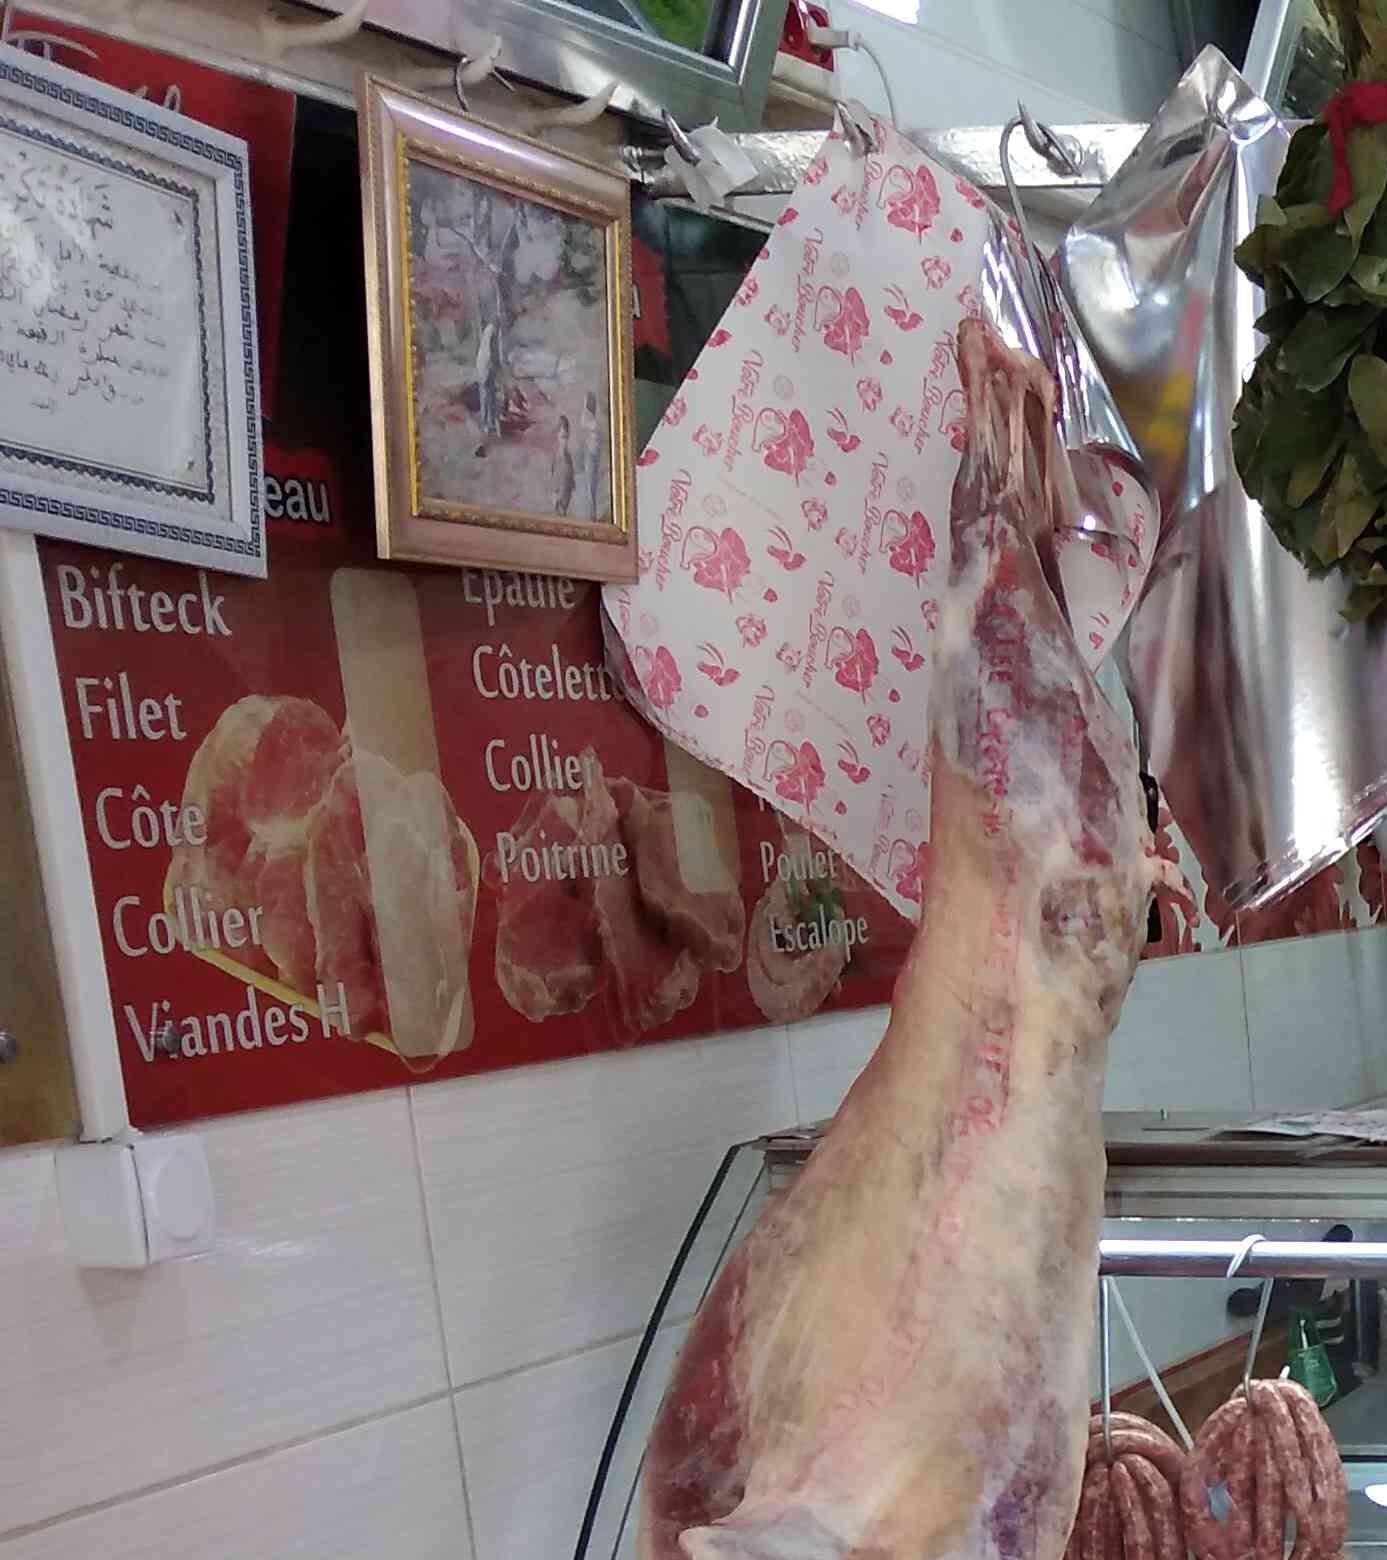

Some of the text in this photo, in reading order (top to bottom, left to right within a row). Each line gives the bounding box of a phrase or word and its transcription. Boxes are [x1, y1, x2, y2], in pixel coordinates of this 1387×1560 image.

[263, 474, 331, 524] eau
[57, 561, 233, 637] Bifteck
[75, 671, 188, 742] Filet
[484, 733, 596, 793] Collier
[96, 784, 209, 850] Côte
[495, 829, 631, 884] Poitrine
[759, 840, 839, 885] Poulet
[113, 886, 264, 957] Collier
[770, 904, 869, 963] Escalope
[124, 984, 311, 1064] Viandes
